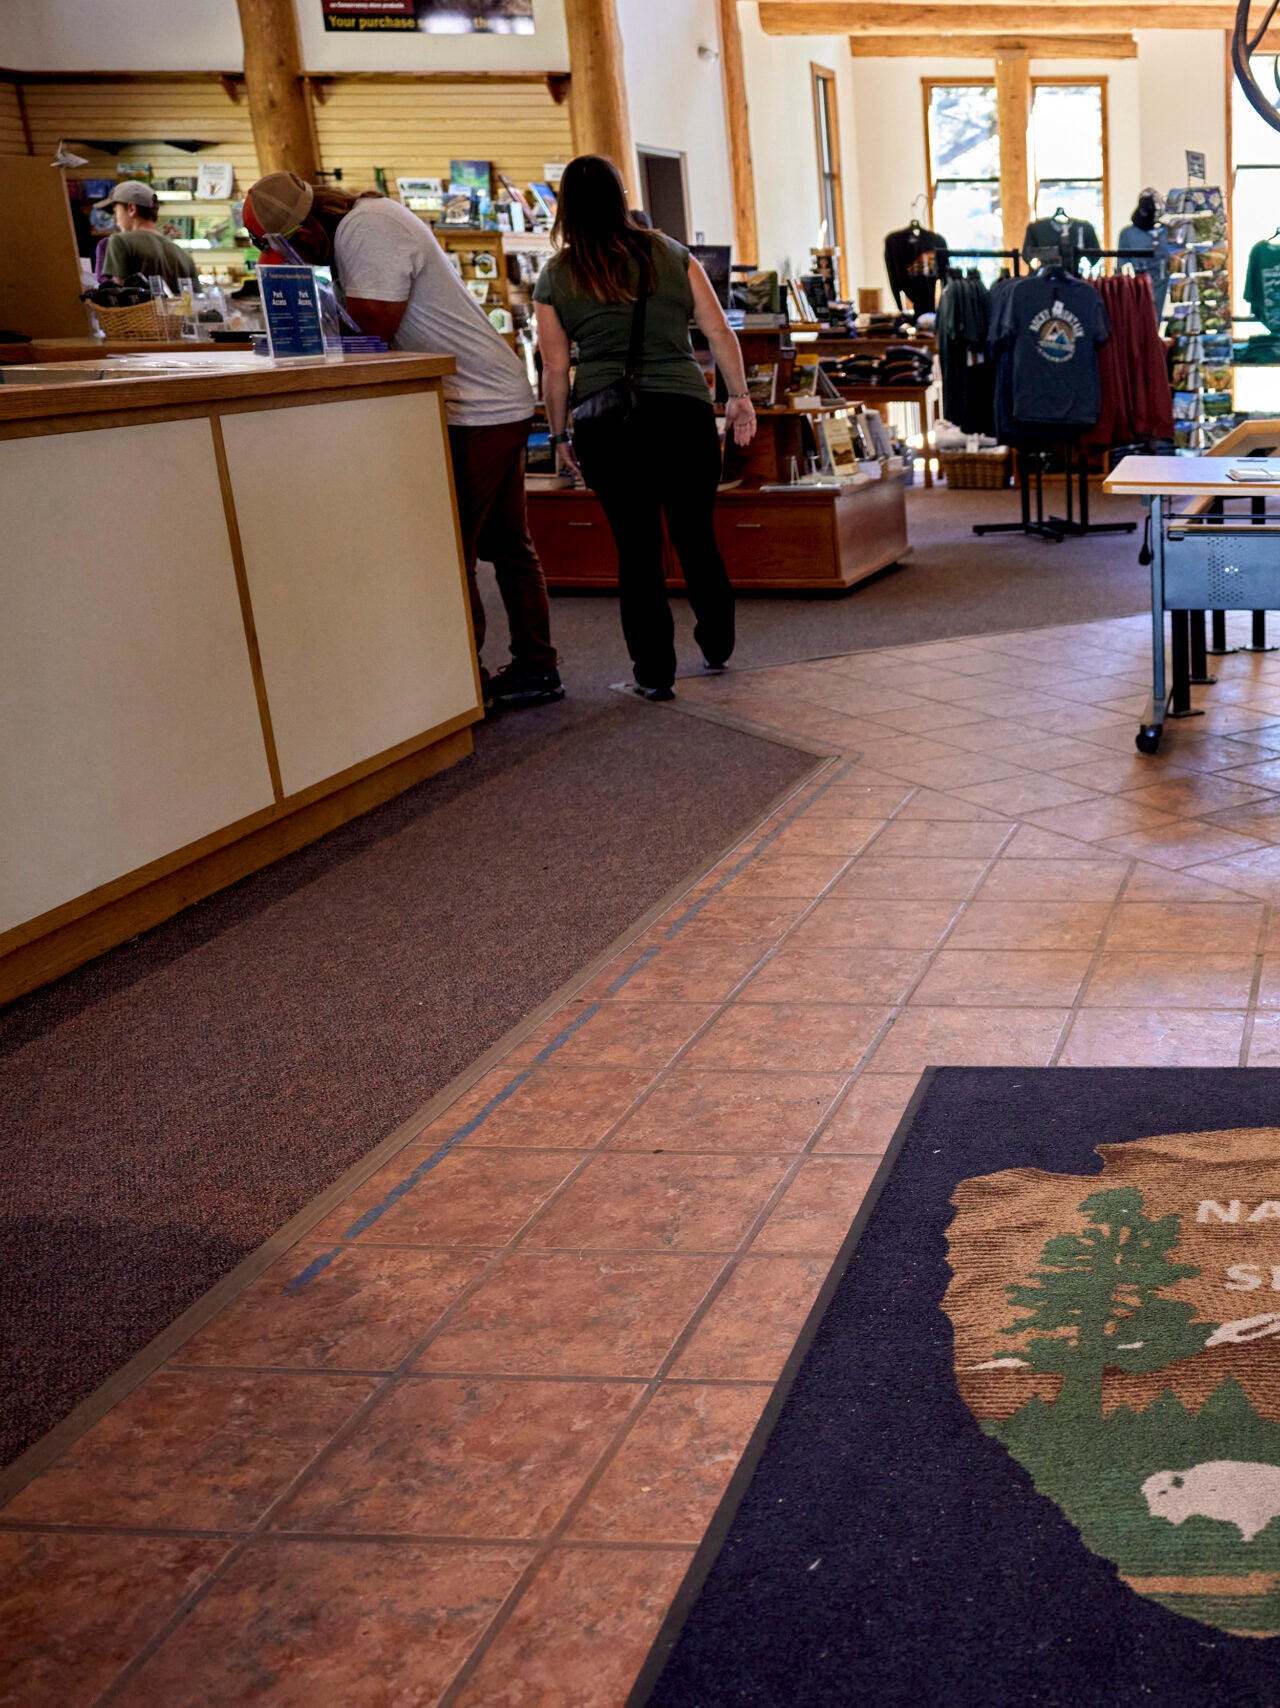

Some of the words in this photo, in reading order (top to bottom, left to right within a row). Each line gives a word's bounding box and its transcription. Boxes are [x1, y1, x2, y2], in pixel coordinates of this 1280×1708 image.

[328, 15, 356, 28] Your
[359, 15, 414, 30] purchase
[272, 290, 284, 298] Park
[298, 290, 308, 298] Park
